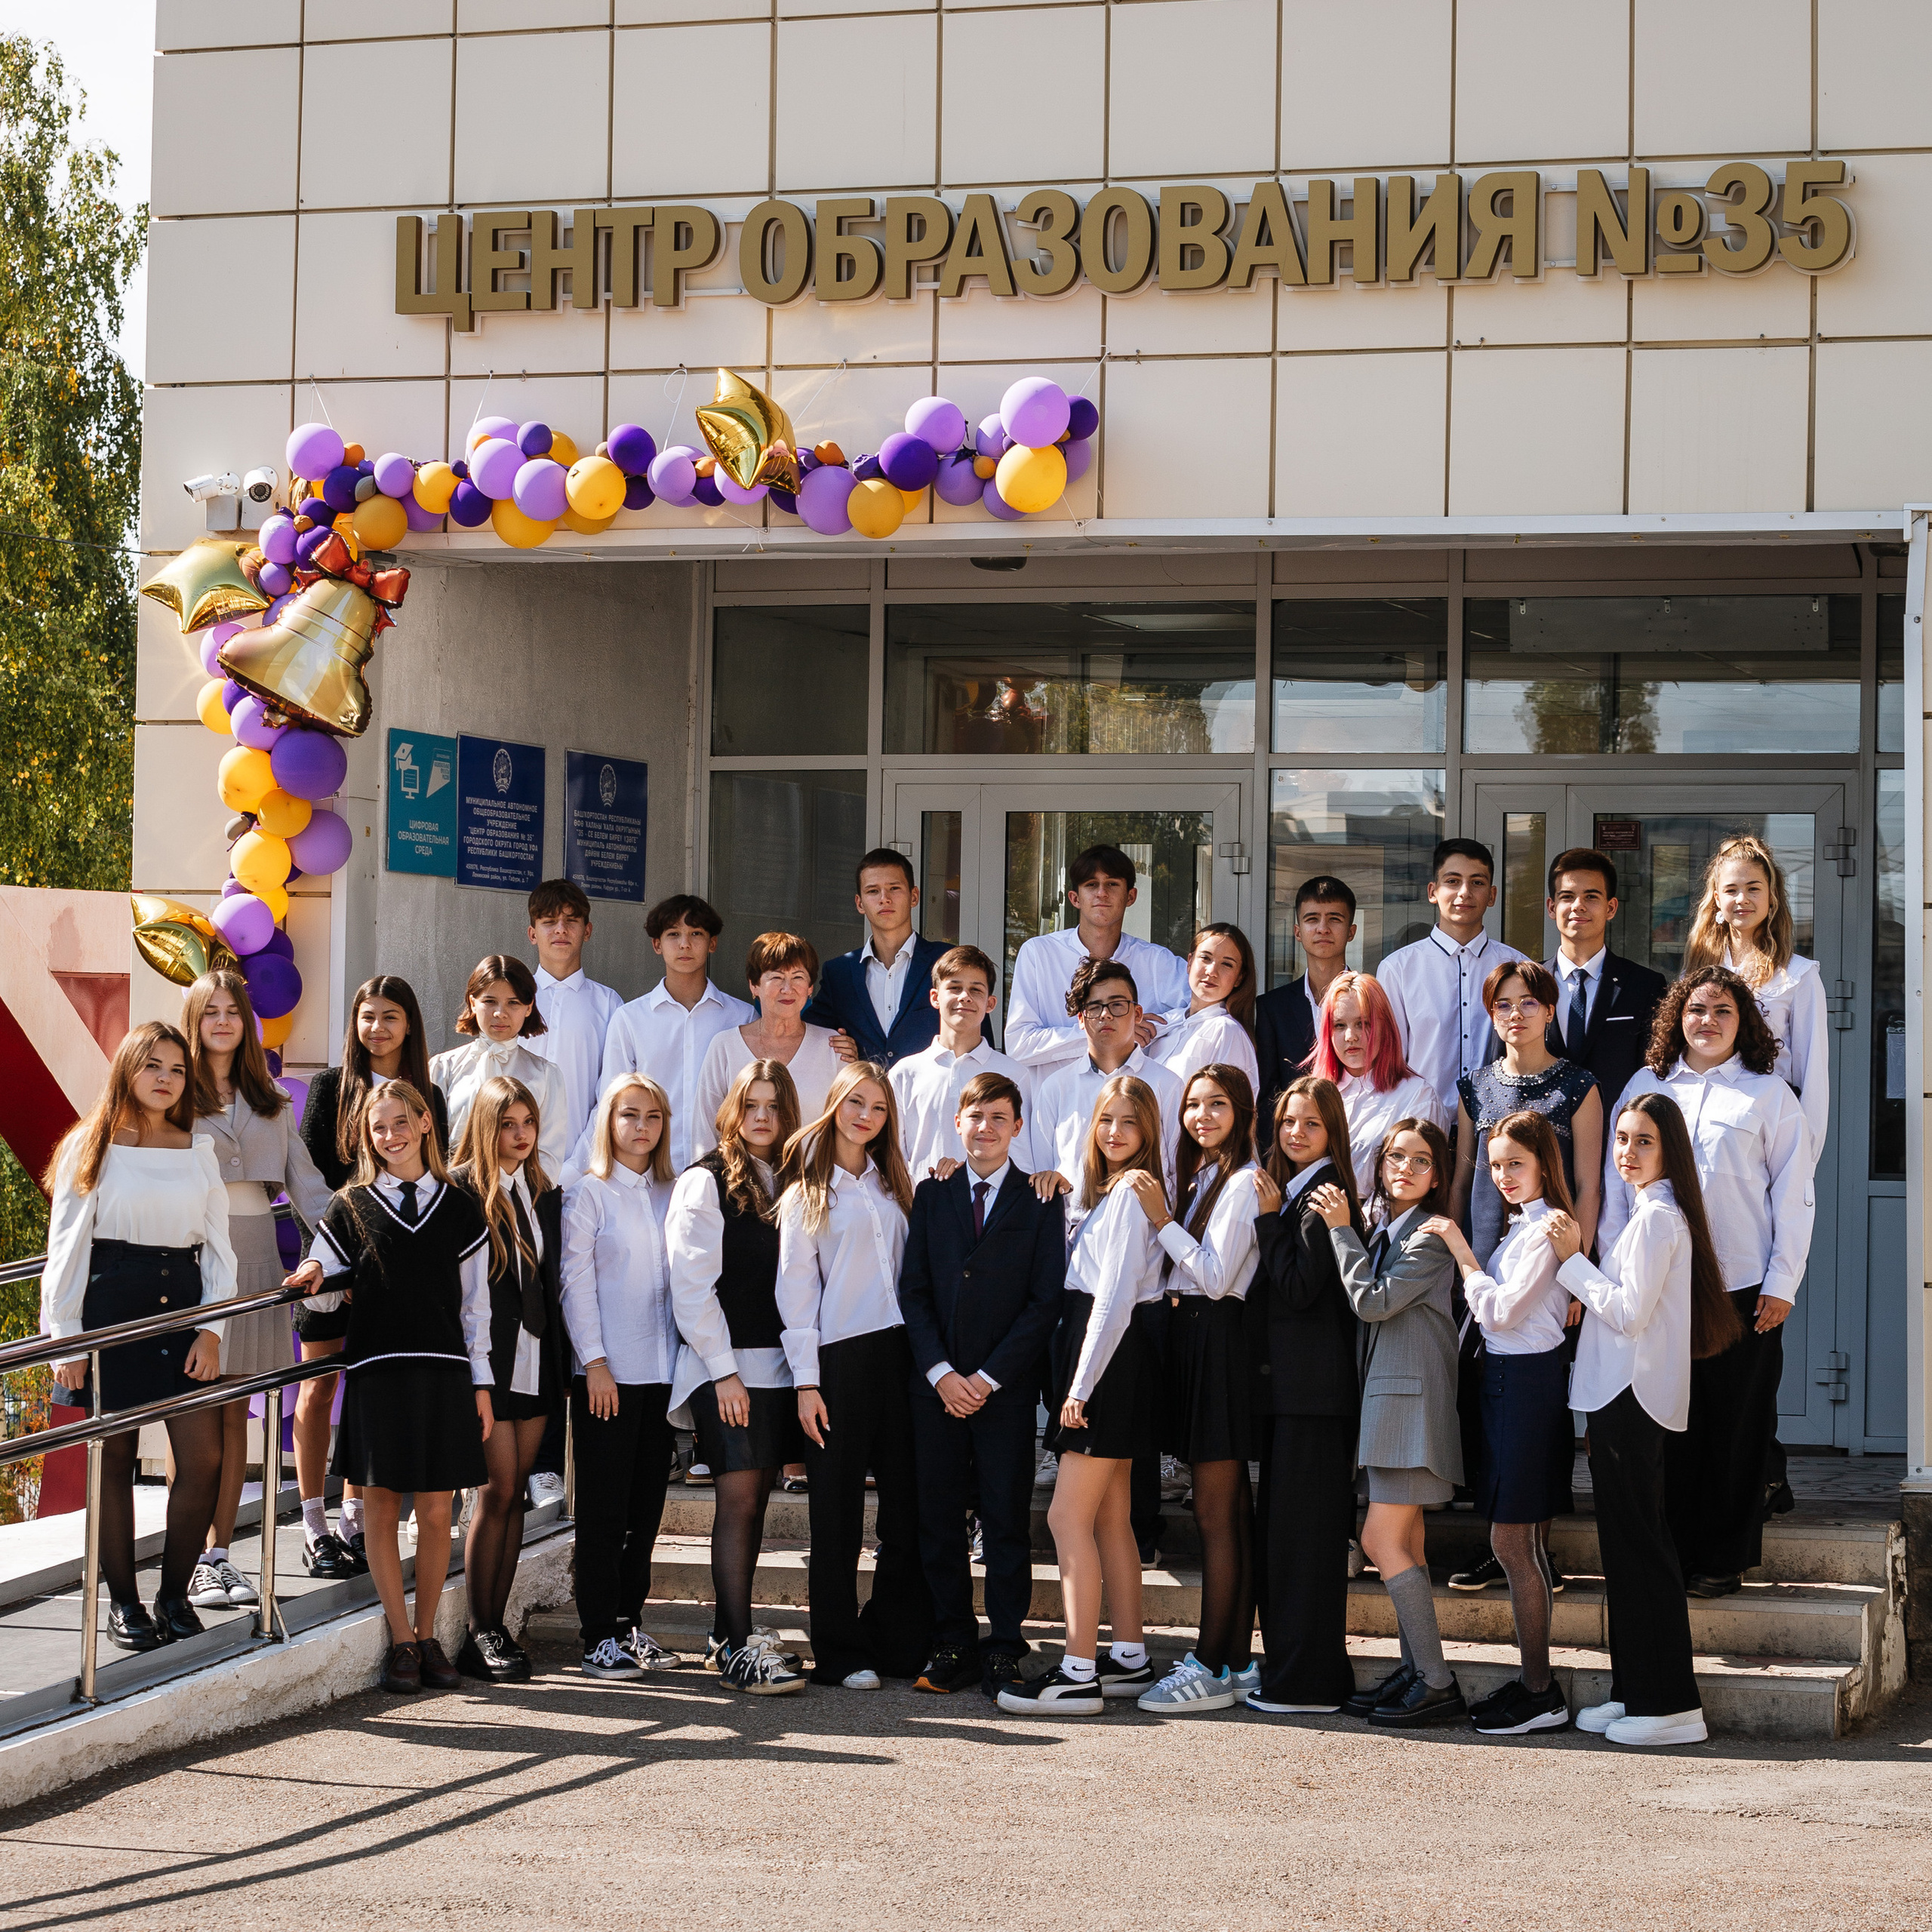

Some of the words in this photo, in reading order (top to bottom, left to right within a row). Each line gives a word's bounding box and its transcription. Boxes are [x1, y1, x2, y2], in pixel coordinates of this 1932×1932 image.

[395, 205, 722, 333] ЦЕНТР
[739, 171, 1541, 306] ОБРАЗОВАНИЯ
[1575, 161, 1854, 282] №35
[466, 797, 506, 808] МУНИЦИПАЛЬНОЕ
[507, 803, 537, 813] АВТОНОМНОЕ
[473, 808, 531, 821] ОБЩЕОБРАЗОВАТЕЛЬНОЕ
[409, 820, 438, 832] ЦИФРОВАЯ
[487, 819, 517, 829] УЧРЕЖДЕНИЕ
[398, 831, 449, 845] ОБРАЗОВАТЕЛЬНАЯ
[486, 829, 519, 839] ОБРАЗОВАНИЯ
[594, 832, 608, 840] БЕЛЕМ
[463, 836, 494, 847] ГОРОДСКОГО
[513, 843, 528, 851] ГОРОД
[415, 845, 432, 856] СРЕДА
[468, 847, 497, 857] РЕСПУБЛИКИ
[499, 851, 534, 861] БАШКОРТОСТАН
